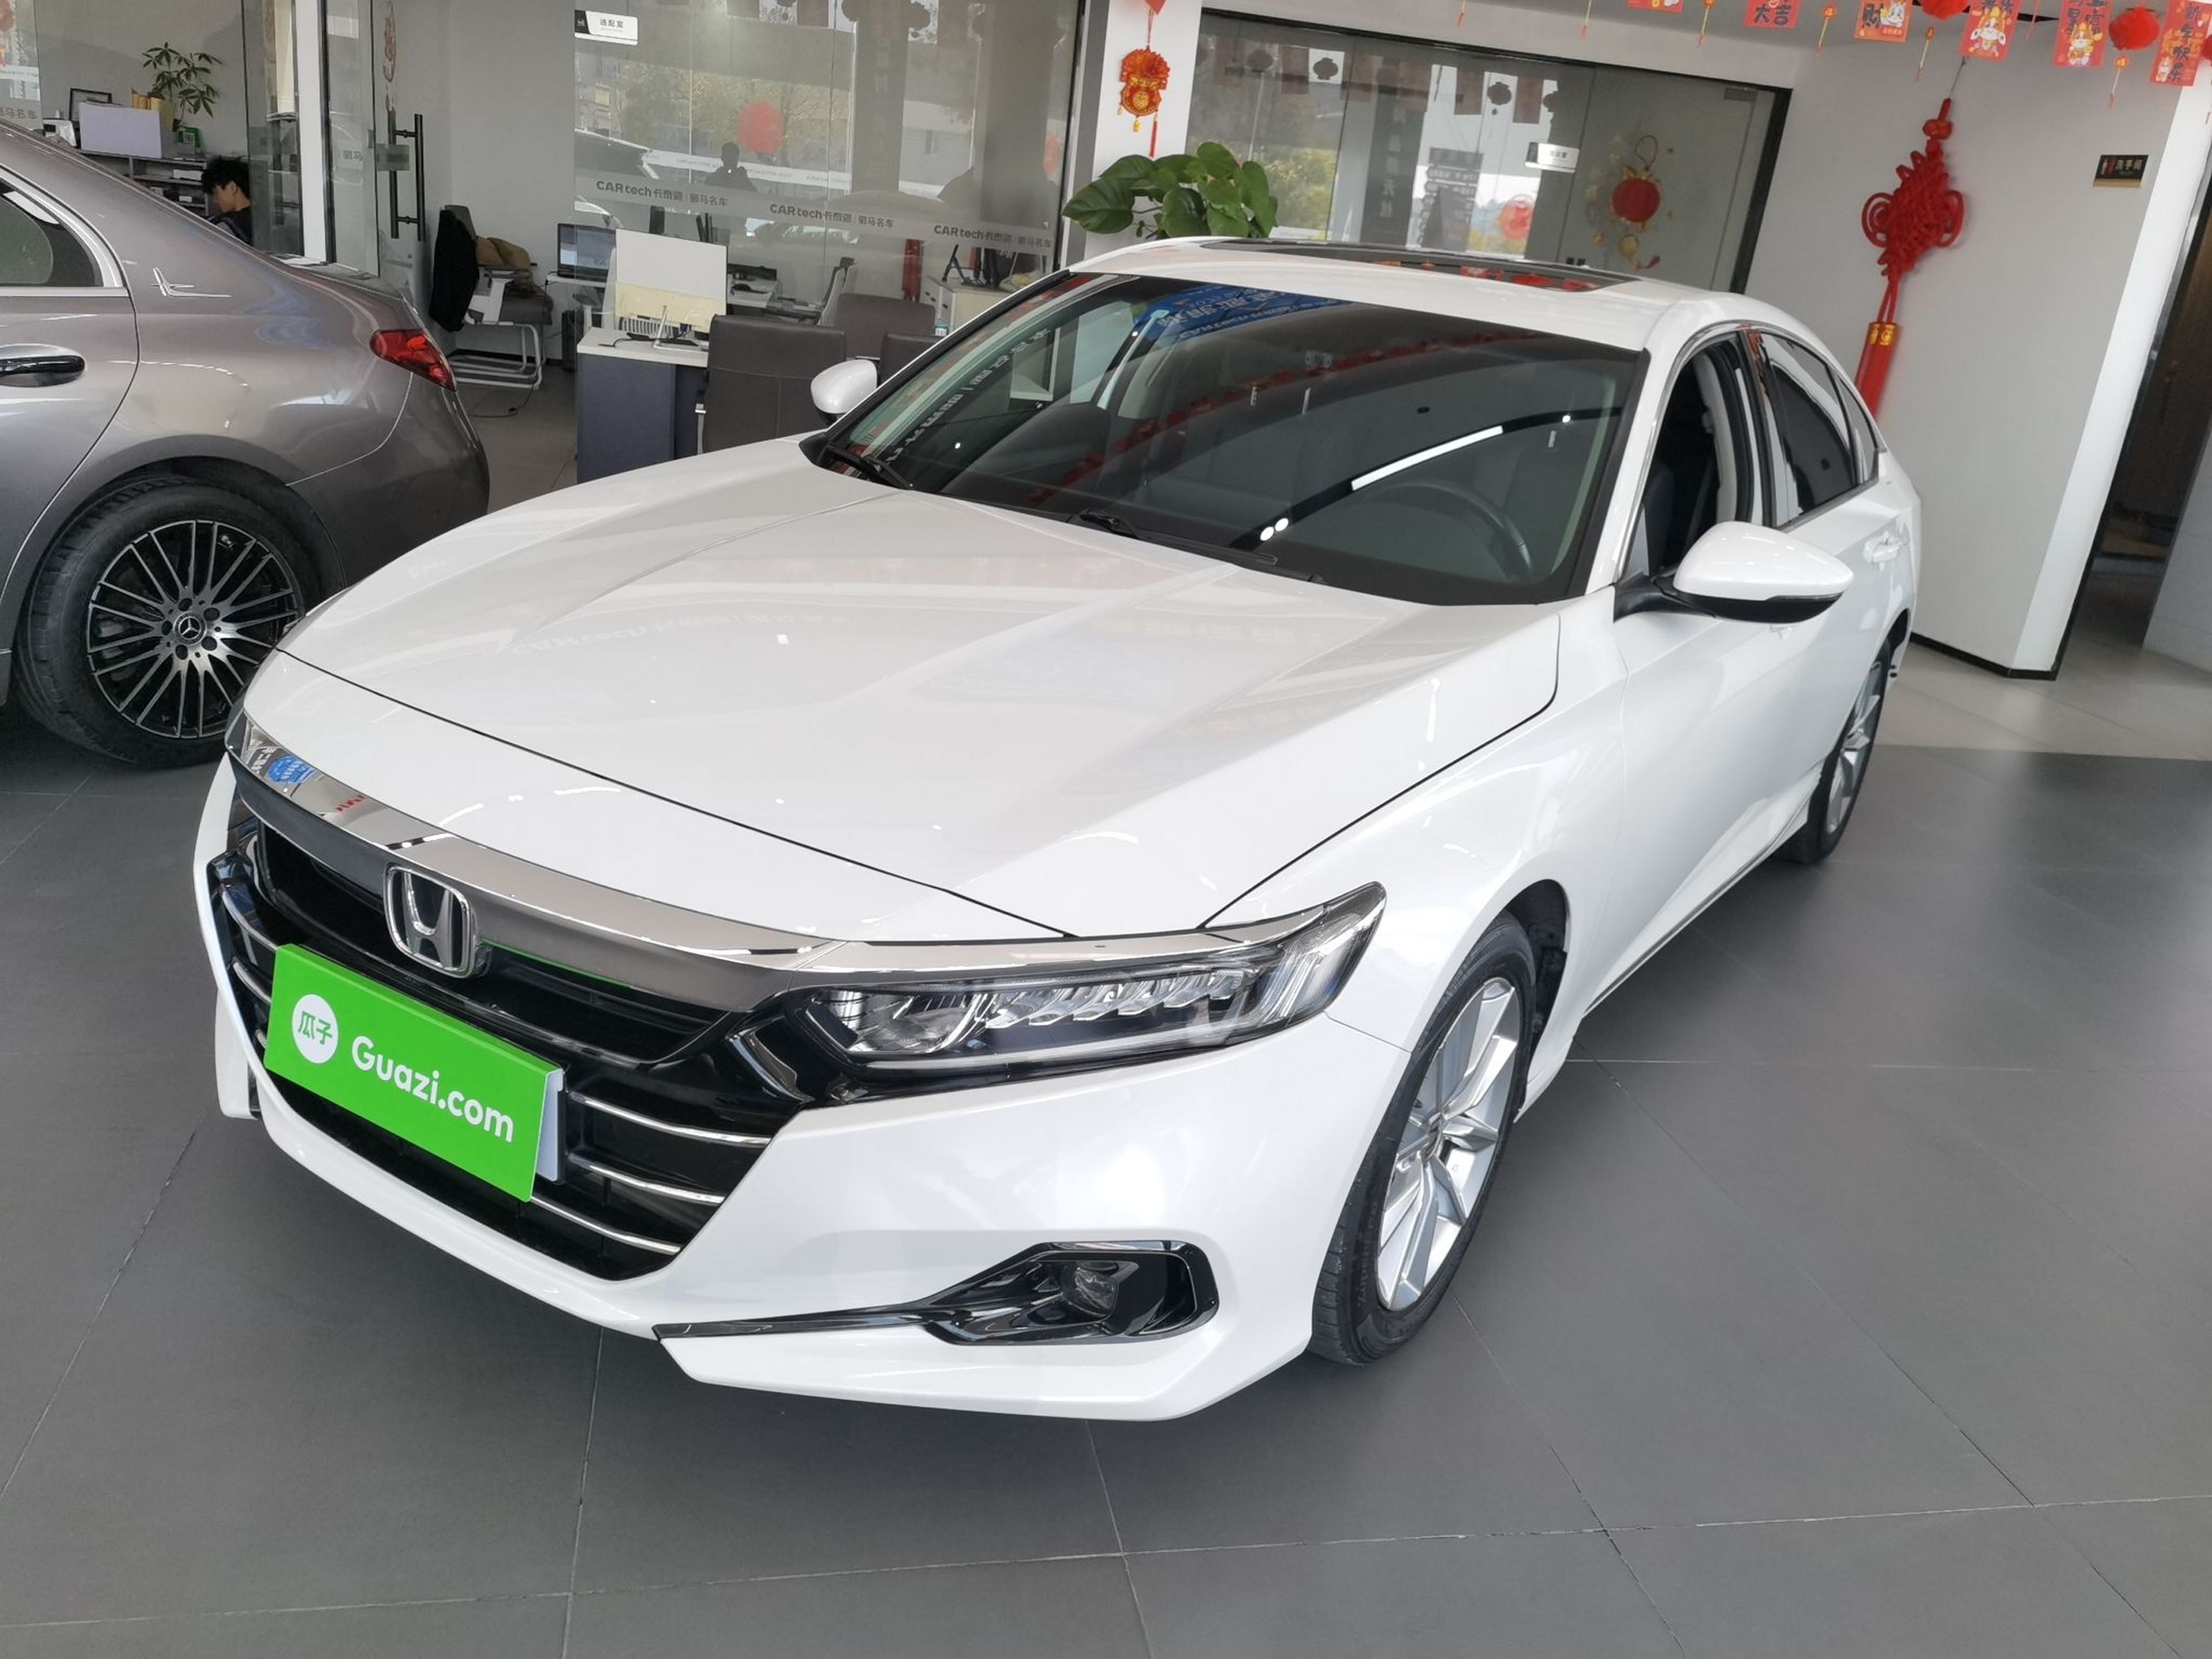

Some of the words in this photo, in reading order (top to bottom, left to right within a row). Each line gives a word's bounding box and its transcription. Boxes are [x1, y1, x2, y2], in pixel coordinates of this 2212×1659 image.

[1753, 5, 1791, 25] 大吉
[596, 181, 652, 196] CARtech
[770, 204, 822, 220] CARtech
[934, 225, 984, 240] CARtech
[298, 1011, 333, 1045] 瓜子
[351, 1036, 514, 1143] Guazi.com
